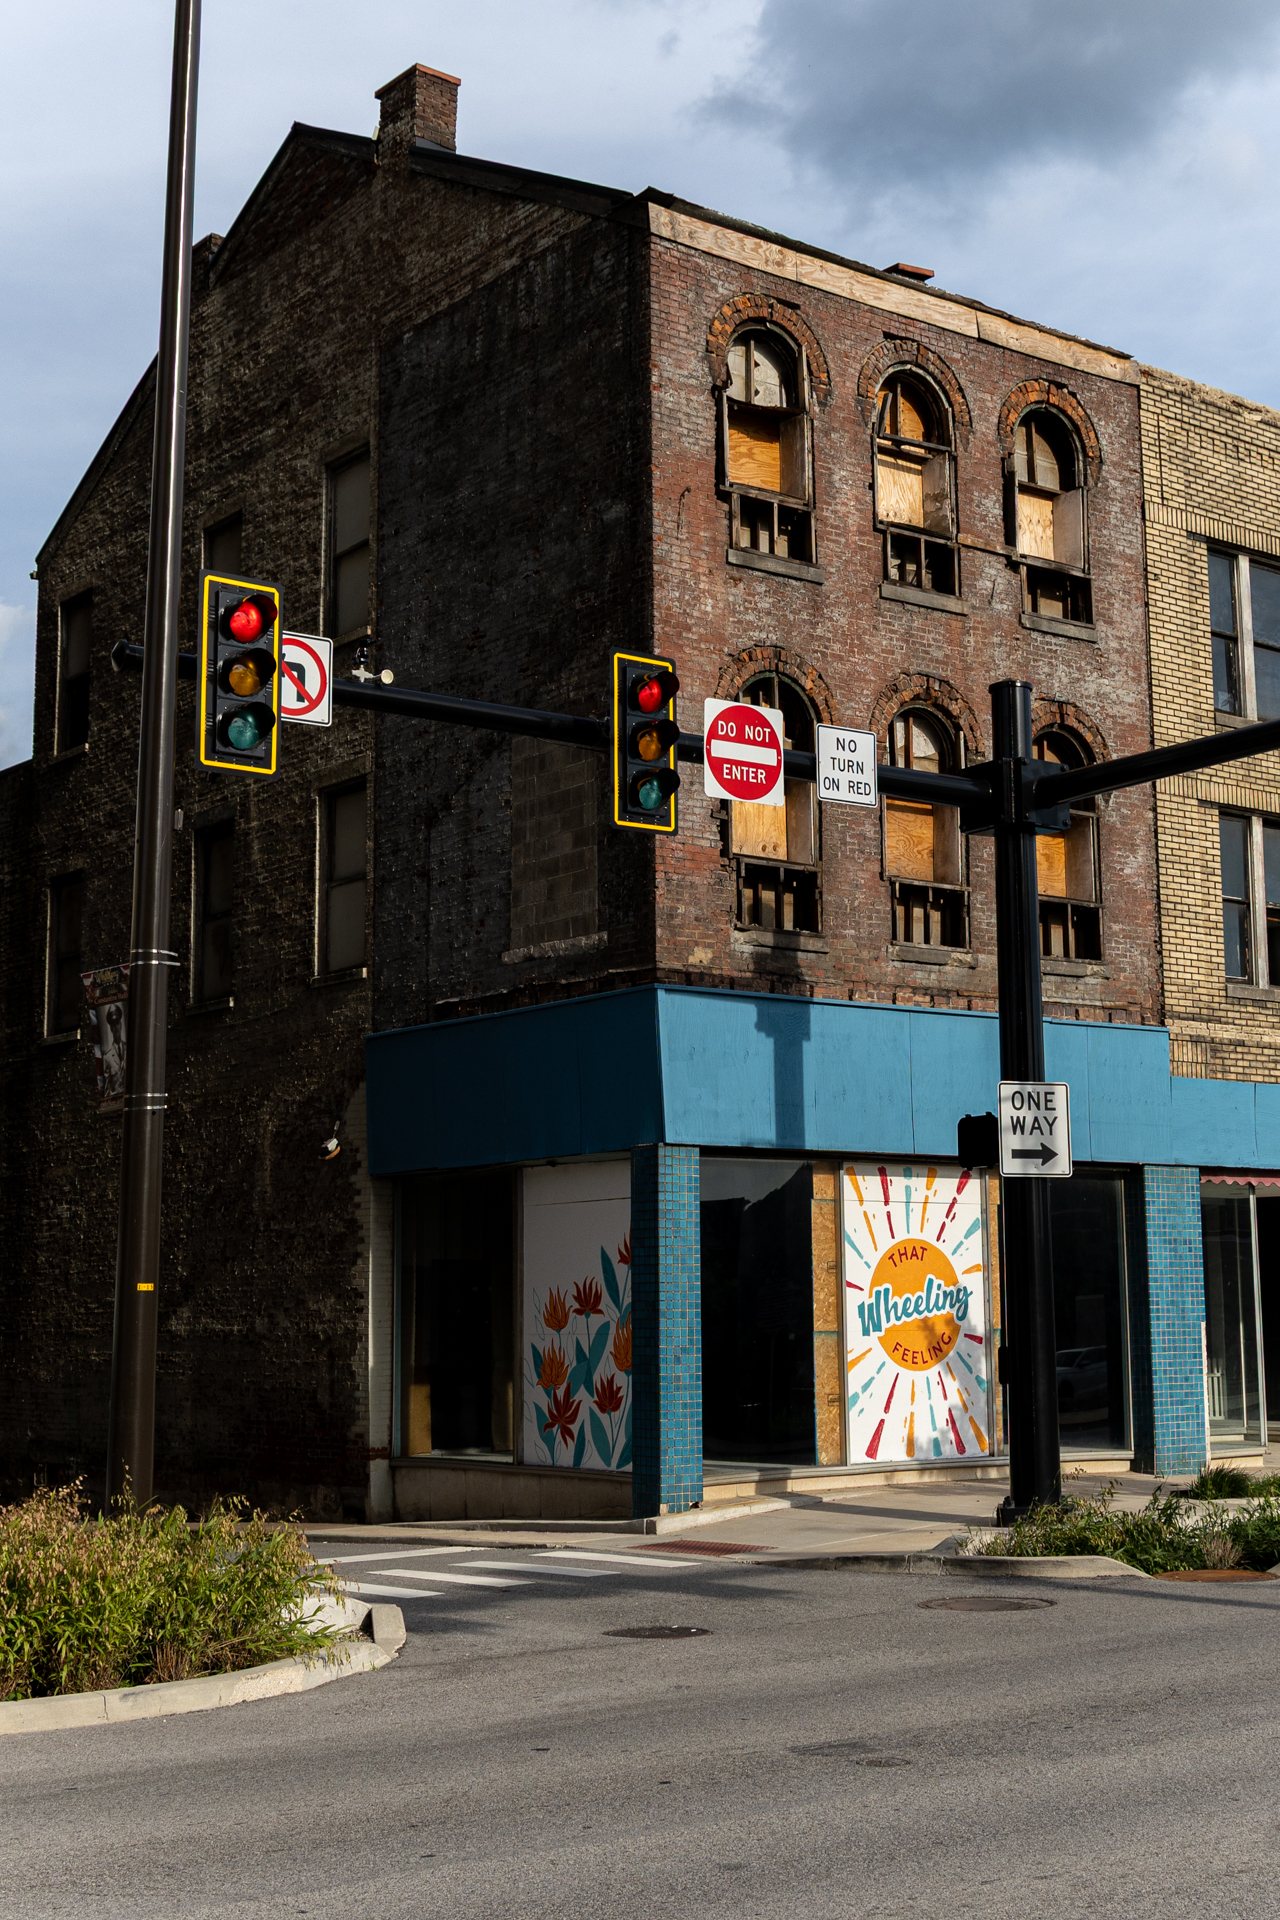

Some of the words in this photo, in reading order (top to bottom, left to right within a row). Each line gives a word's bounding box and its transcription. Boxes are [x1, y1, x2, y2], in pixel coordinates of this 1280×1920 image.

[717, 720, 737, 737] DO
[745, 725, 771, 743] NOT
[836, 737, 857, 753] NO
[723, 764, 766, 785] ENTER
[830, 757, 864, 775] TURN
[823, 776, 840, 792] ON
[848, 780, 872, 796] RED
[1011, 1091, 1056, 1111] ONE
[1010, 1115, 1058, 1136] WAY
[888, 1245, 928, 1268] THAT
[858, 1277, 973, 1337] Wheeling
[892, 1331, 952, 1365] FEELING
